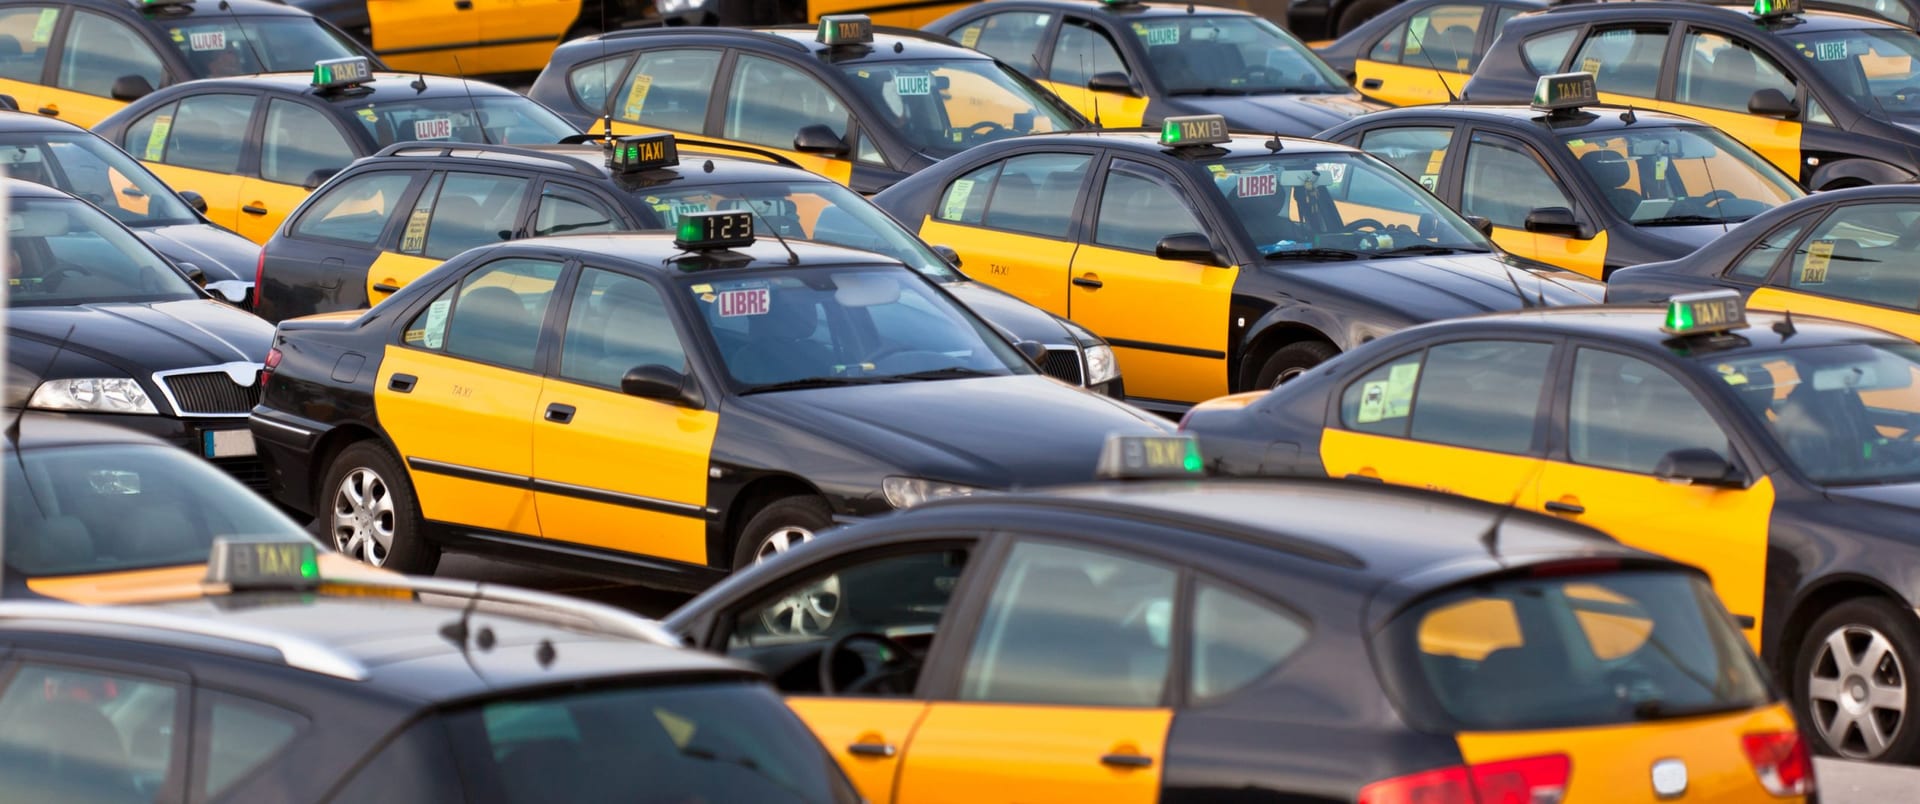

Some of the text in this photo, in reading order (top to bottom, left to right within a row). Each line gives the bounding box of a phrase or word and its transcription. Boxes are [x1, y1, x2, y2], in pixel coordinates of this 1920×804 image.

[839, 23, 859, 38] TAXI
[192, 32, 223, 49] LLIURE
[1818, 43, 1846, 59] LIBRE
[332, 63, 357, 80] TAXI
[898, 77, 928, 94] LLIURE
[1557, 82, 1581, 99] TAXI
[417, 120, 450, 138] LLIURE
[1182, 121, 1209, 139] TAXI
[638, 141, 663, 161] TAXI
[1239, 174, 1275, 197] LIBRE
[707, 215, 751, 240] 123
[405, 236, 423, 251] TAXI
[990, 264, 1009, 276] TAXI
[1804, 268, 1825, 282] TAXI
[721, 289, 767, 315] LIBRE
[1693, 302, 1726, 325] TAXI
[452, 385, 472, 398] TAXI
[256, 544, 300, 576] TAXI
